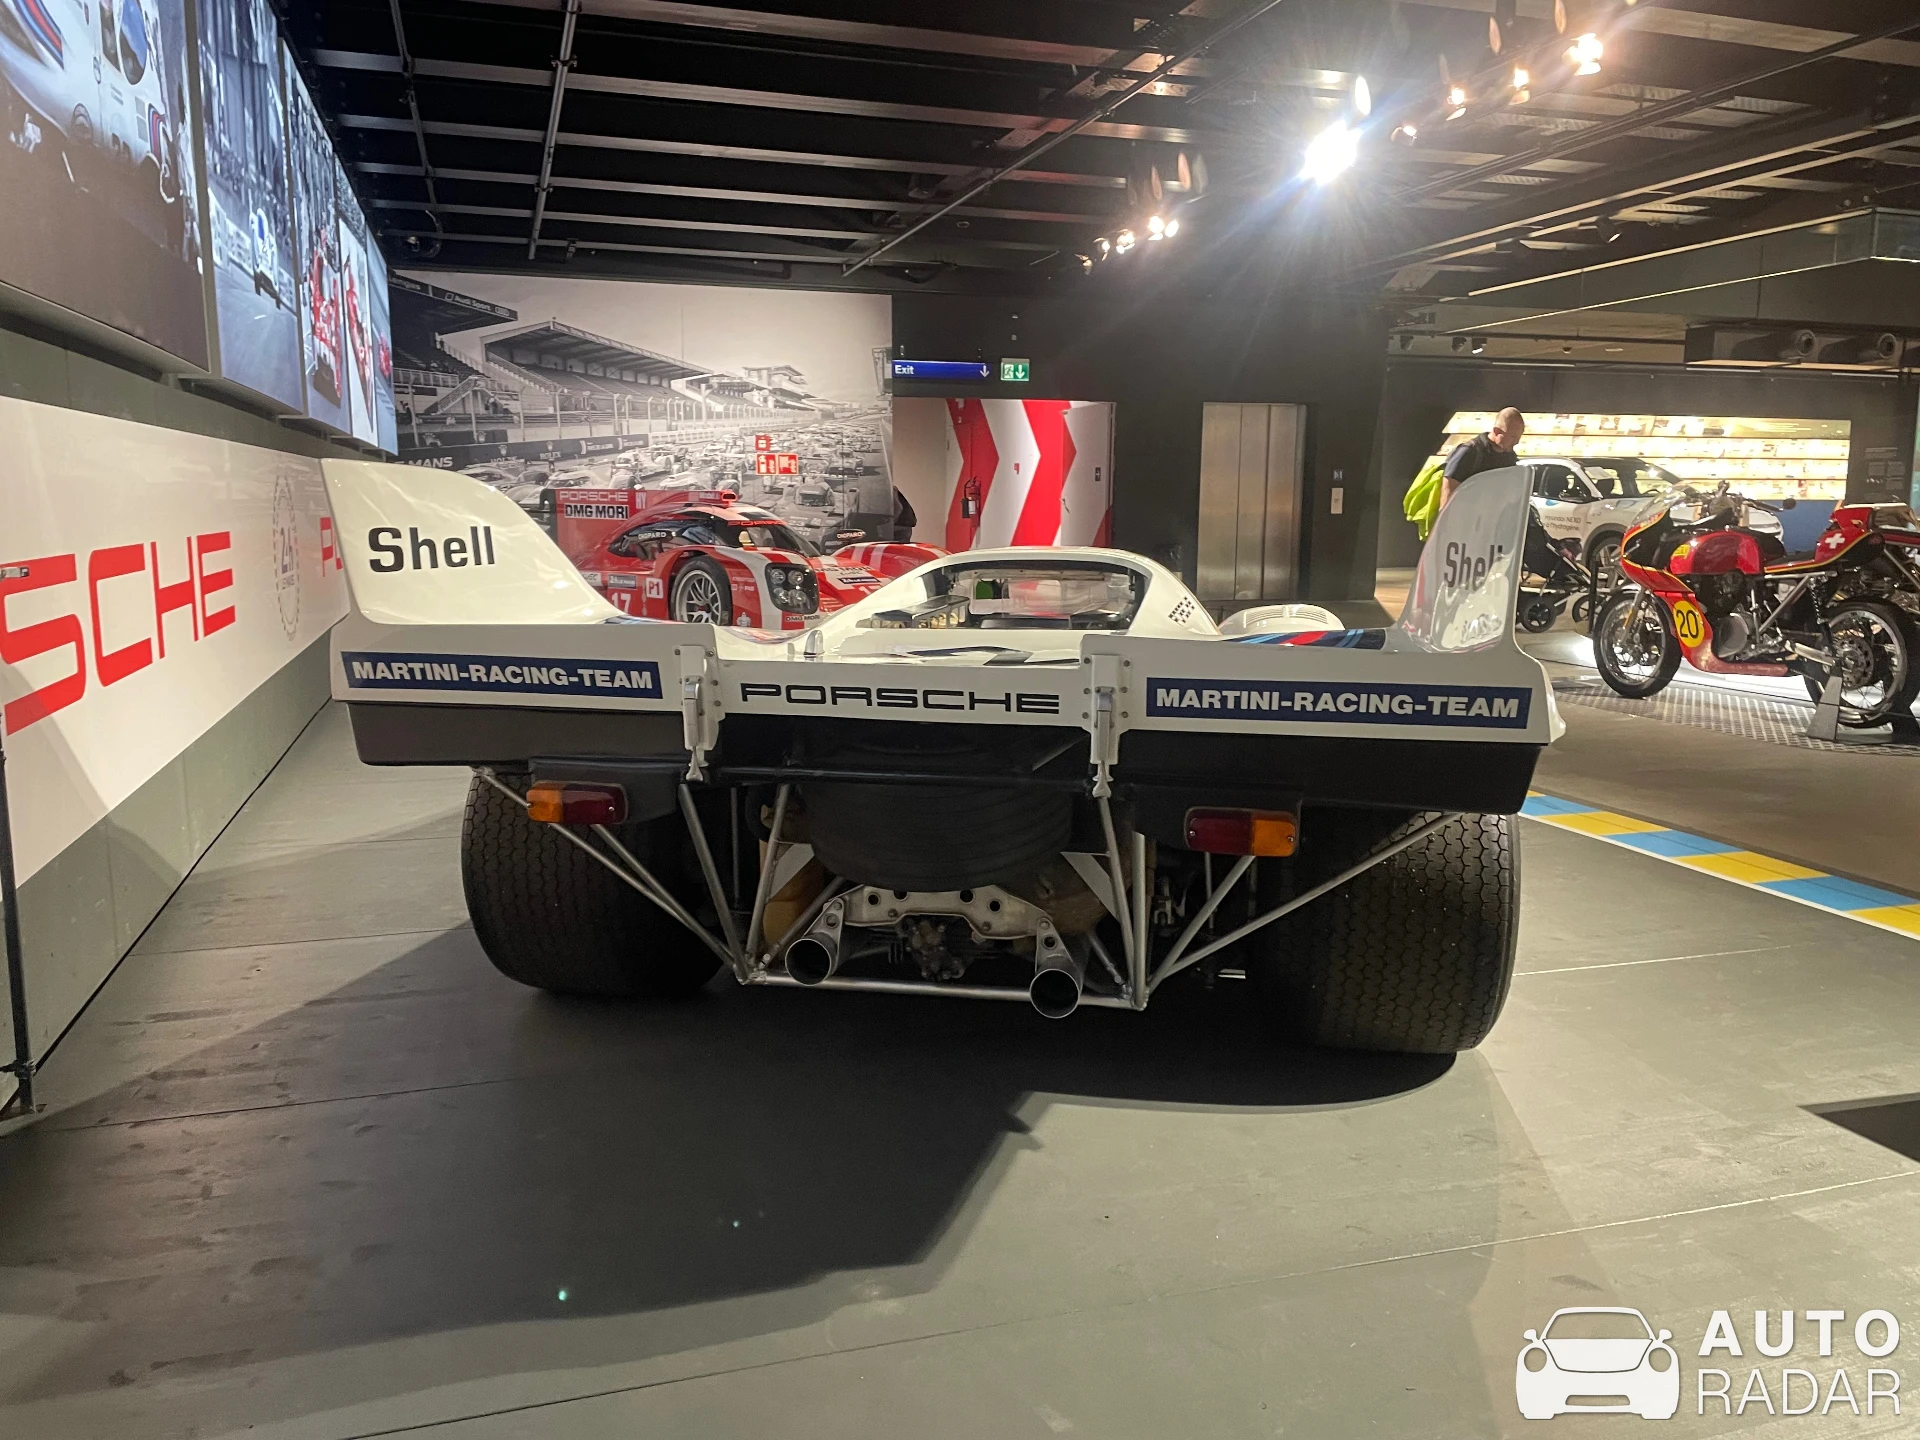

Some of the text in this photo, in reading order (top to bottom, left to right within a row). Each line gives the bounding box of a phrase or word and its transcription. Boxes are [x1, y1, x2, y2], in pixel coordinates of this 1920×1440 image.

[894, 364, 914, 375] Exit
[560, 490, 628, 502] PORSCHE
[564, 504, 629, 519] DMG MORI
[368, 526, 495, 573] Shell
[648, 582, 660, 596] P1
[611, 592, 631, 615] 17
[1676, 609, 1699, 639] 20
[352, 661, 653, 690] MARTINI-RACING-TEAM
[740, 683, 1060, 714] PORSCHE
[1156, 688, 1519, 718] MARTINI-RACING-TEAM
